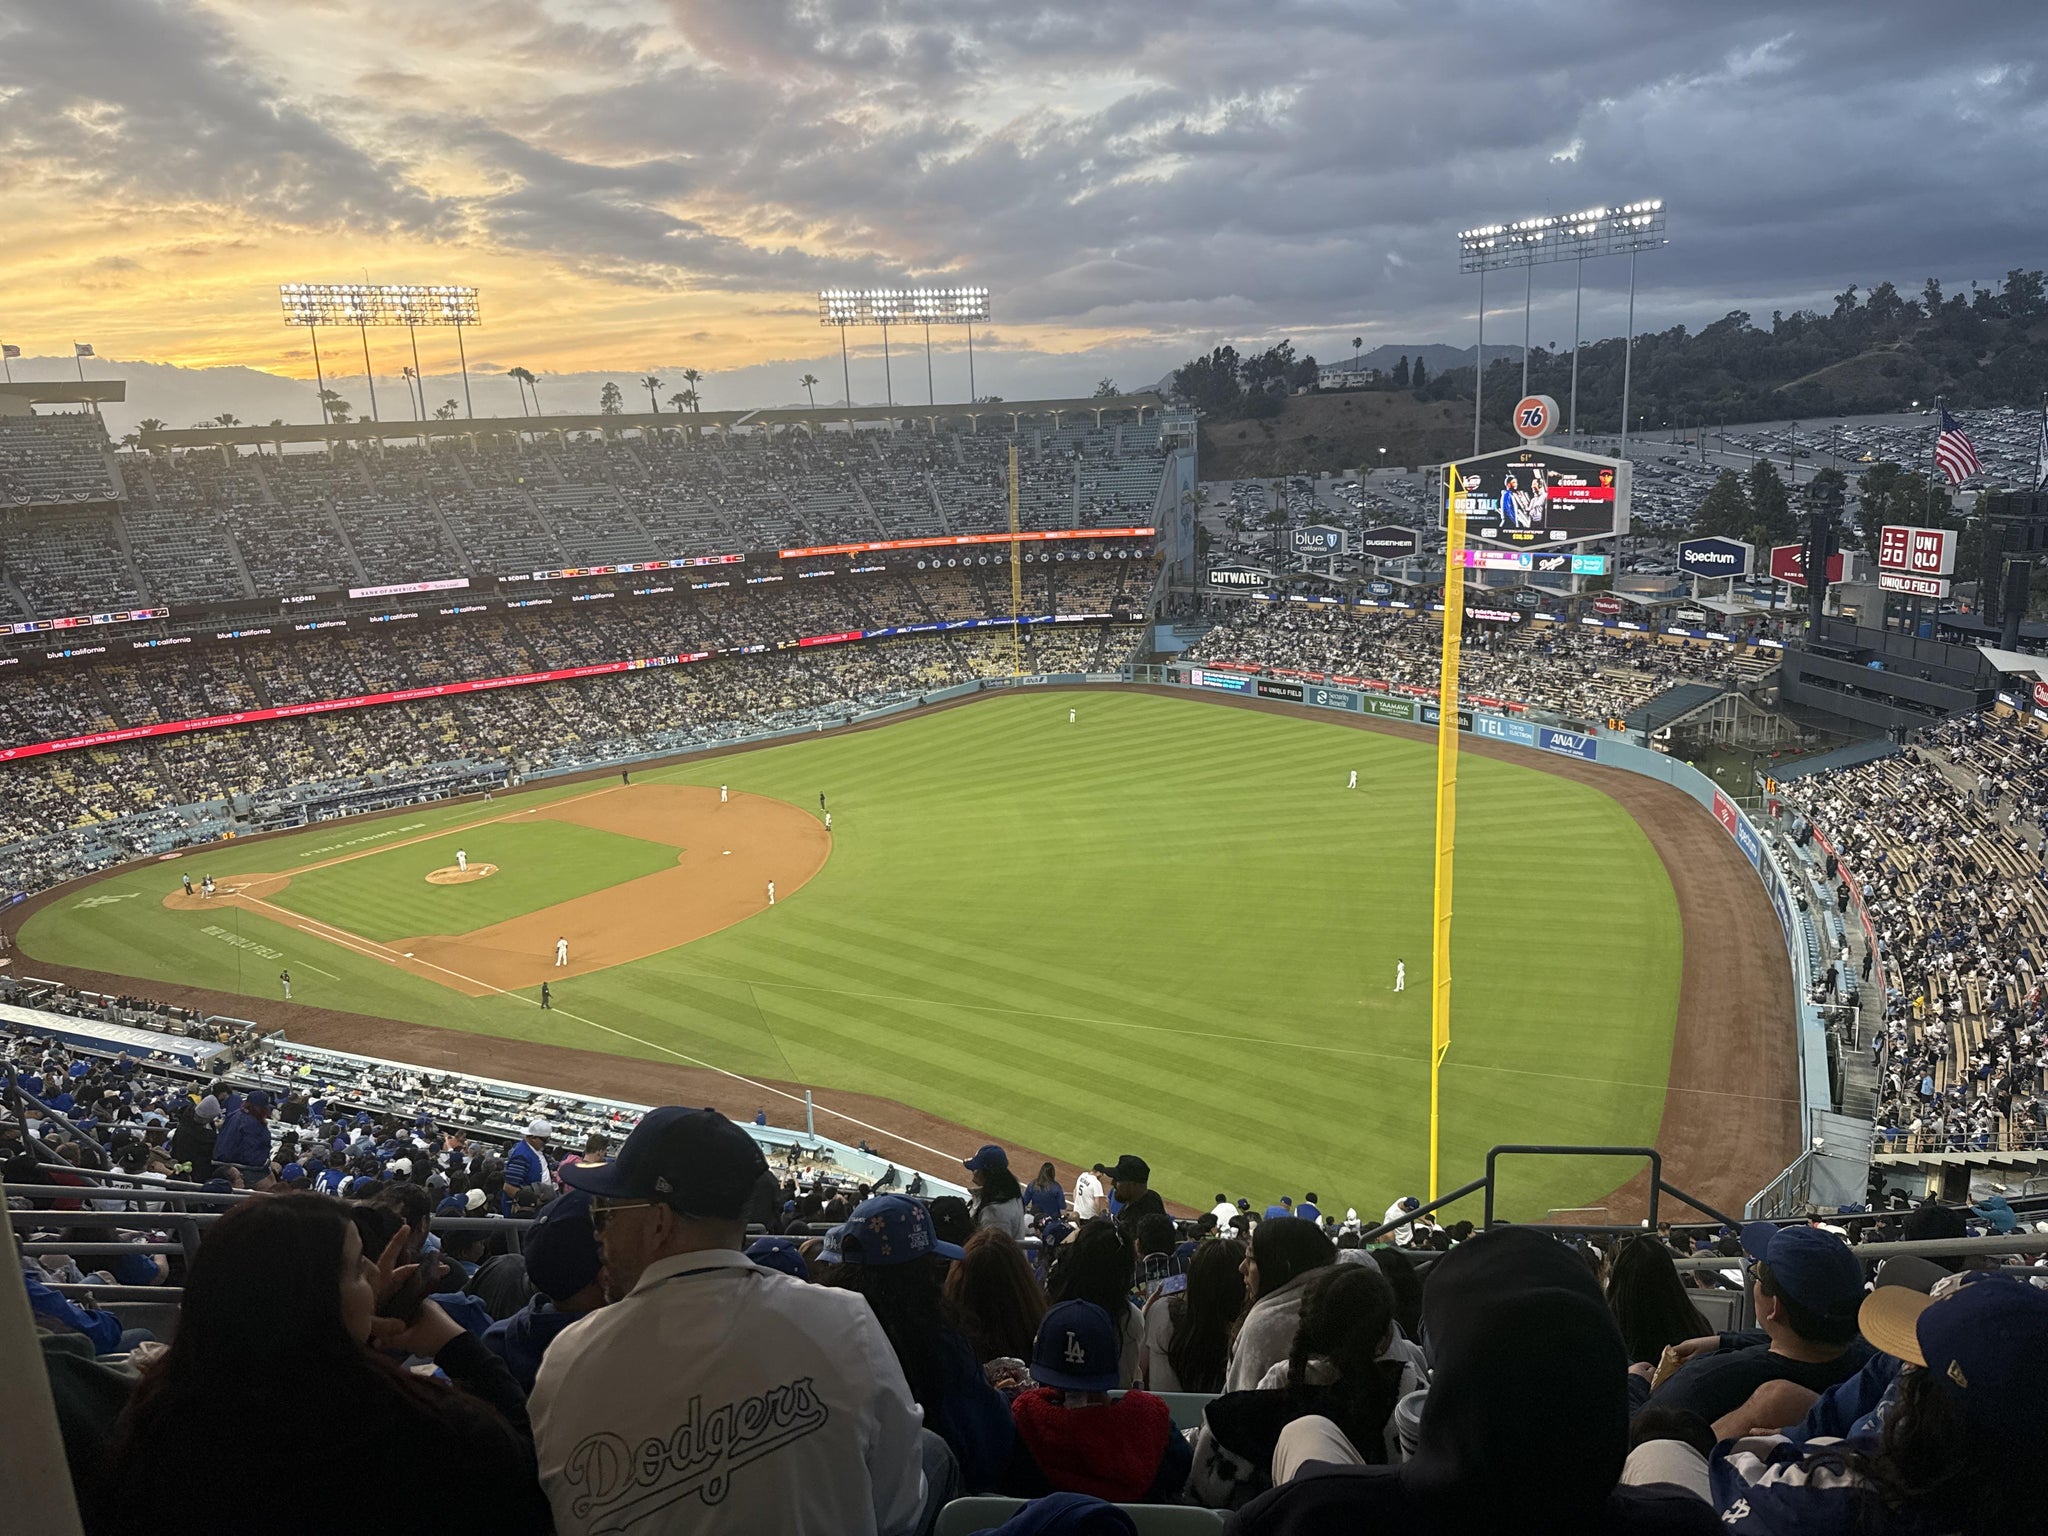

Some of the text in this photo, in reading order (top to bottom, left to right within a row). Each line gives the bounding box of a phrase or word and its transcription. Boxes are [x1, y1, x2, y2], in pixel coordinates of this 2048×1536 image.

[1520, 405, 1543, 428] 76
[1477, 499, 1498, 510] TALK
[1295, 531, 1324, 546] blue
[1366, 539, 1413, 547] GUGGENHEIM
[1883, 532, 1904, 548] ユニ
[1915, 536, 1938, 552] UNI
[1684, 549, 1735, 564] Spectrum
[1914, 552, 1938, 568] QLO
[1539, 555, 1565, 570] Dodgers
[1881, 576, 1936, 594] UNIQLO FIELD
[590, 592, 615, 600] california
[526, 598, 552, 606] california
[1595, 602, 1619, 610] Yakult
[460, 605, 487, 613] california
[390, 612, 418, 621] california
[316, 620, 346, 628] california
[240, 628, 271, 637] california
[157, 636, 191, 647] california
[71, 646, 106, 656] california
[1268, 687, 1302, 697] UNIQLO FIELD
[1329, 692, 1349, 702] Security
[1329, 699, 1347, 708] Benefit
[210, 717, 234, 725] AMERICA
[1426, 711, 1440, 720] UCL
[1480, 718, 1505, 736] TEL
[1509, 724, 1524, 732] TOKYO
[1509, 730, 1532, 740] ELECTRON
[1550, 733, 1573, 748] ANA
[300, 830, 398, 857] UNIQLO FIELD
[1738, 822, 1757, 858] Spectrum
[218, 932, 284, 959] UNIQLO FIELD
[1078, 1184, 1084, 1196] 5
[1063, 1331, 1085, 1364] LA
[564, 1376, 829, 1532] Dodgers
